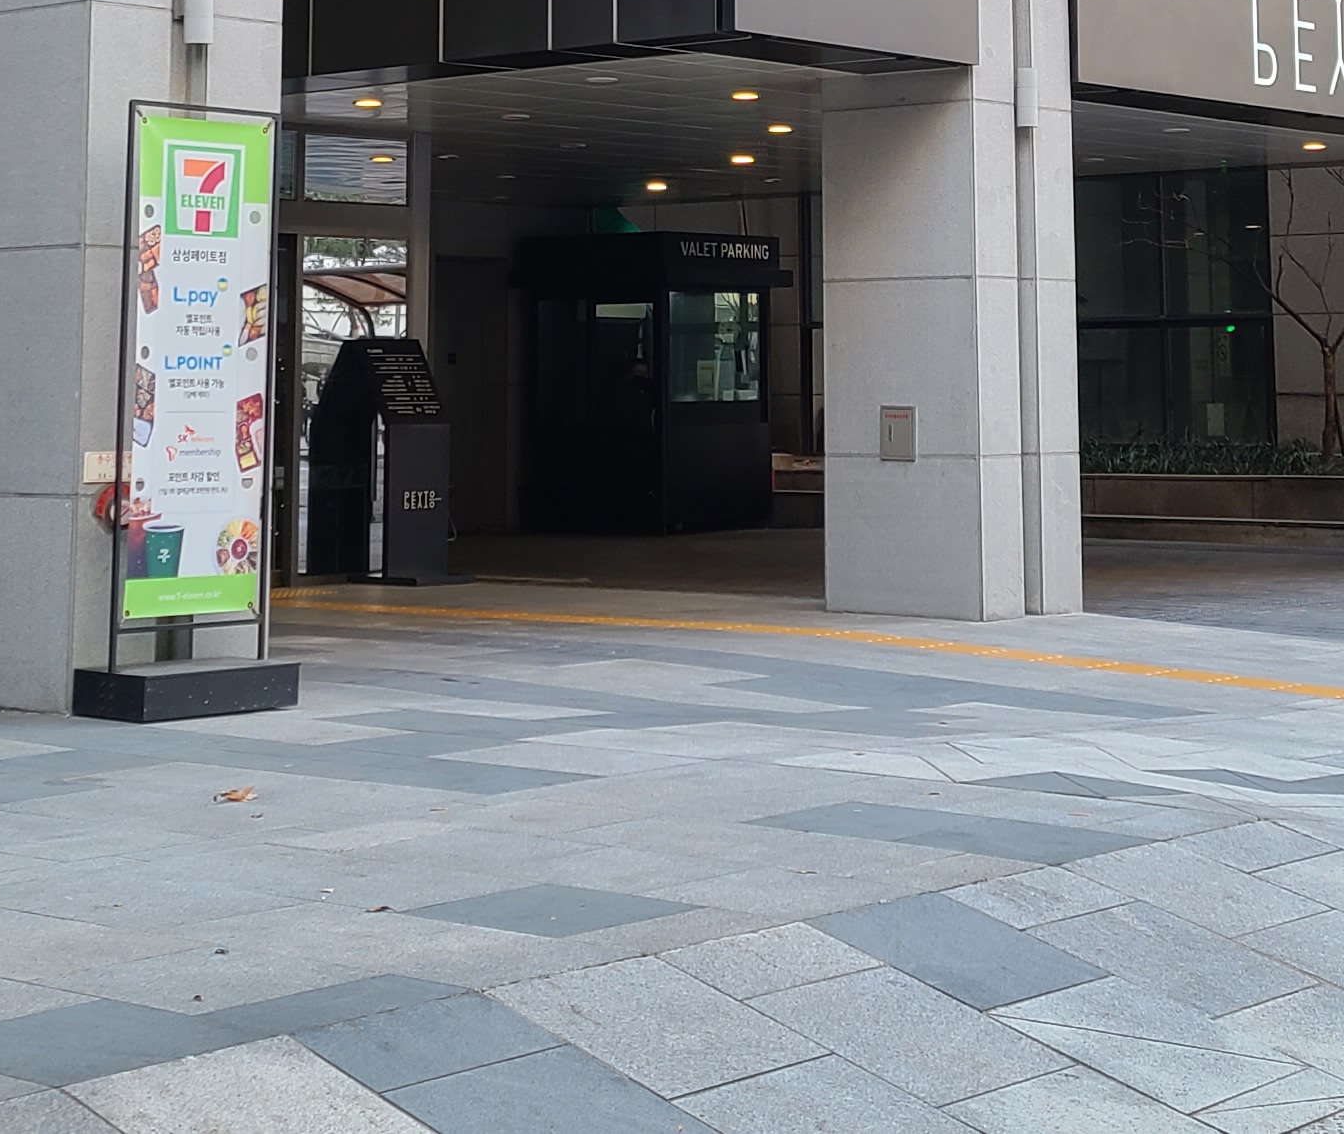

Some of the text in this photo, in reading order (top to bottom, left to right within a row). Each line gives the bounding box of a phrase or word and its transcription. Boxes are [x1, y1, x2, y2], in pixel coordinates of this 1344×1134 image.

[171, 249, 227, 264] 삼성페이토점
[681, 241, 770, 260] VALET PARKING
[173, 287, 218, 307] L.pay
[164, 356, 223, 370] L.POINT
[211, 378, 224, 388] 가능
[177, 434, 188, 443] SK
[179, 447, 222, 458] membership
